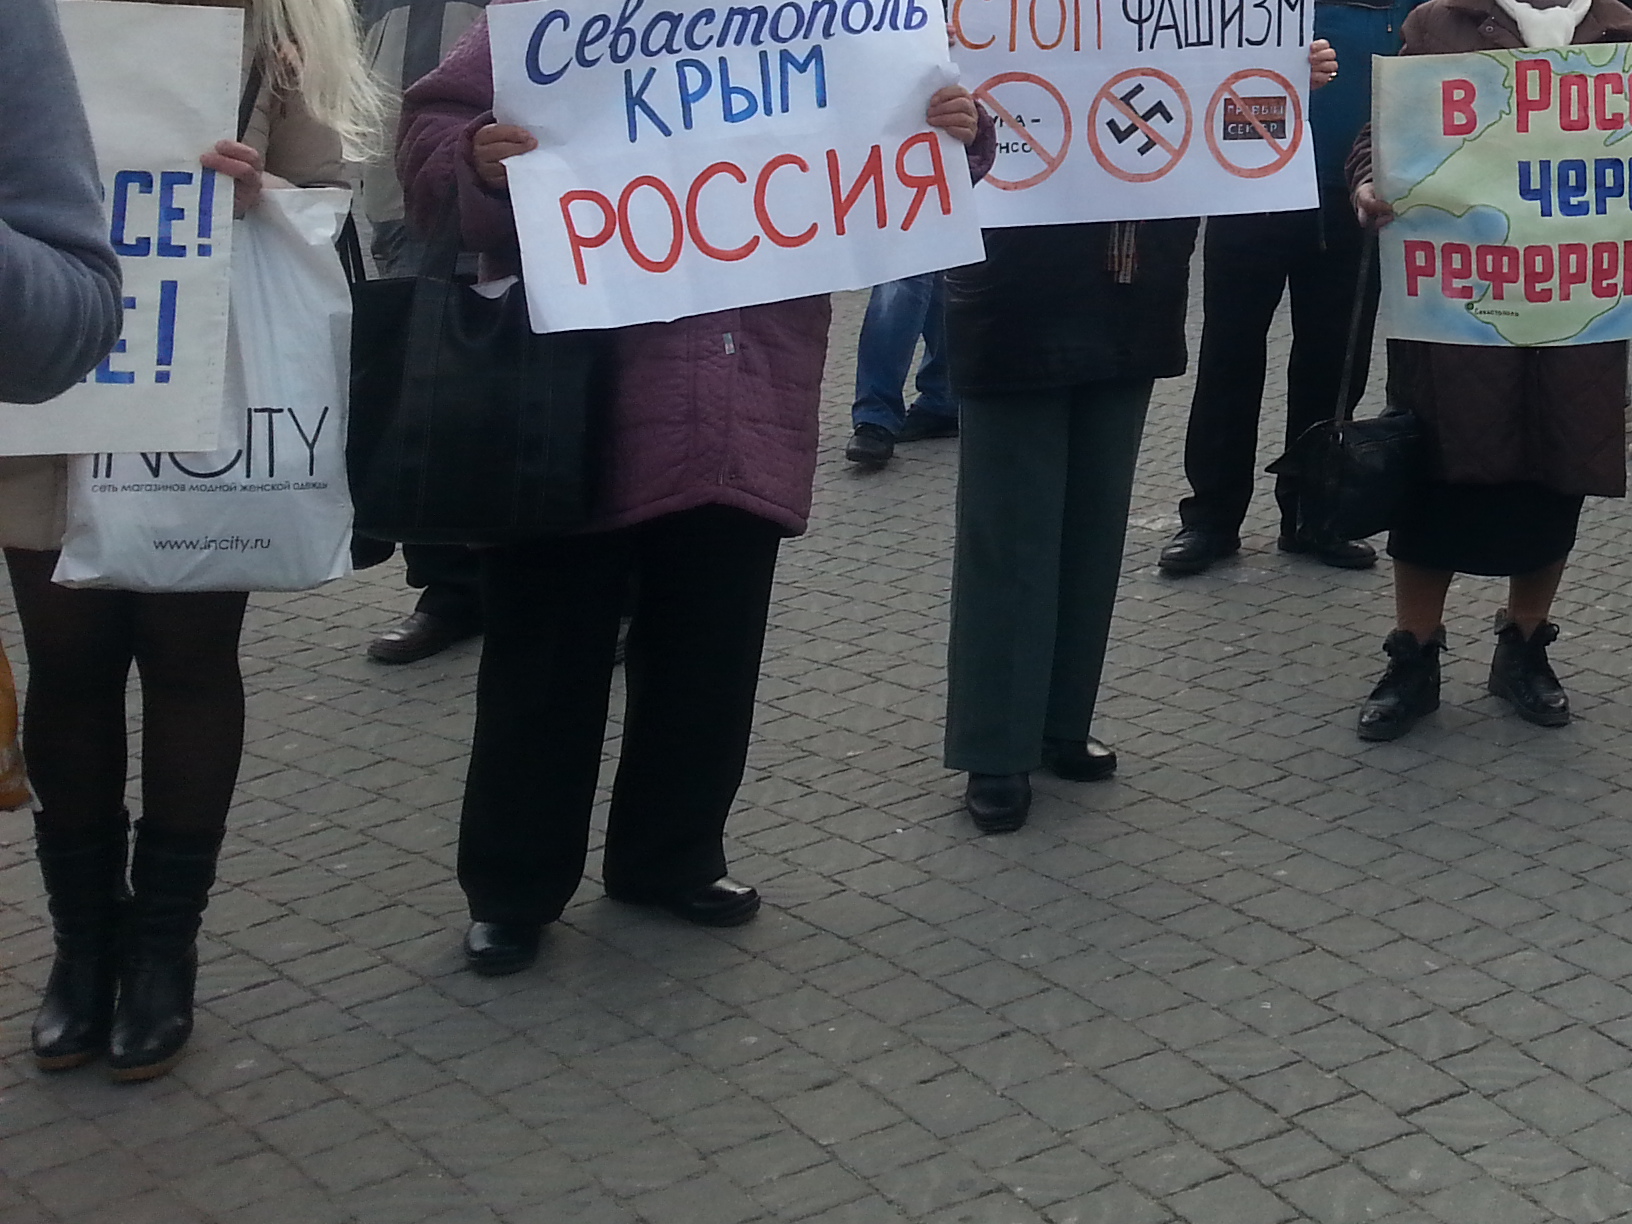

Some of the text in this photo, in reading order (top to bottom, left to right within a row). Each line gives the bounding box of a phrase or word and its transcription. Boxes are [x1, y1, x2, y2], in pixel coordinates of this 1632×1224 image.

[623, 44, 828, 143] КРЫМ
[1441, 78, 1478, 136] В
[102, 167, 217, 258] СЕ!
[559, 131, 952, 285] РОССИЯ
[91, 481, 118, 494] сеть
[120, 481, 186, 494] магазинов
[188, 480, 237, 494] модной
[239, 479, 292, 493] женской
[153, 534, 272, 554] www.incity.ru
